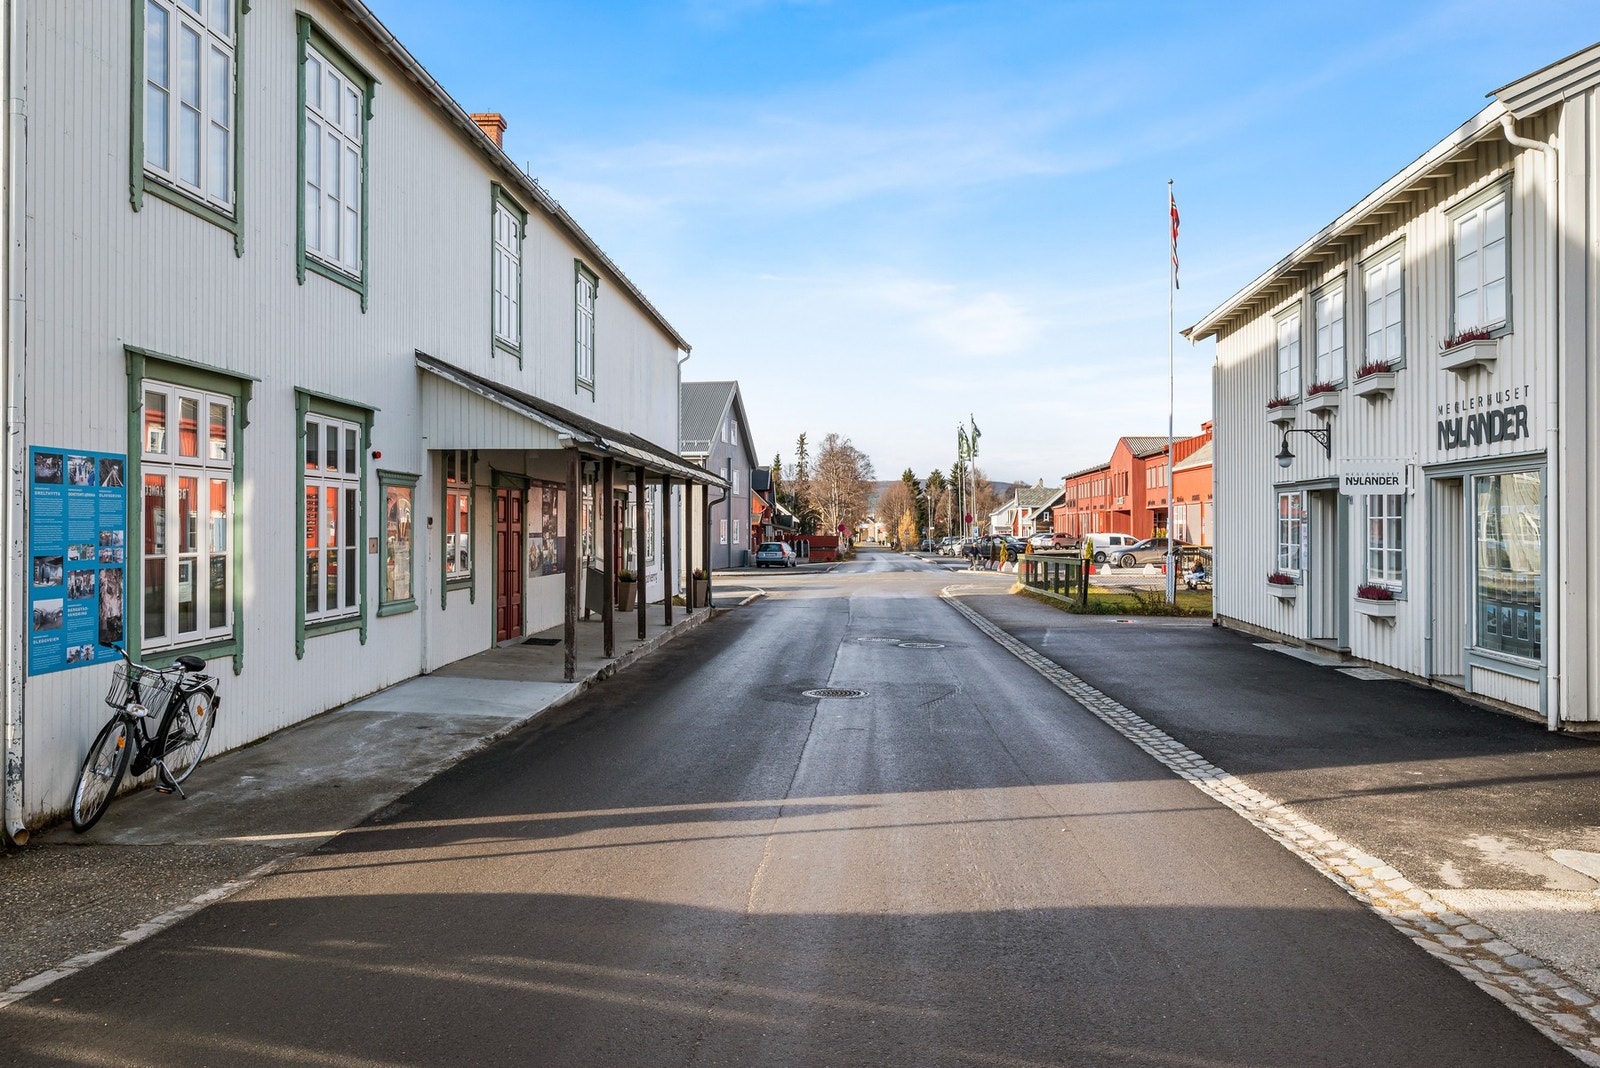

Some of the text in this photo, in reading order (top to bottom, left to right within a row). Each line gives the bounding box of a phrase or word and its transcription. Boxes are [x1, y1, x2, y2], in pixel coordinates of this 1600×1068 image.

[1438, 385, 1530, 416] MEGLERHUSET
[1437, 404, 1530, 451] NYLANDER
[1345, 476, 1399, 486] NYLANDER
